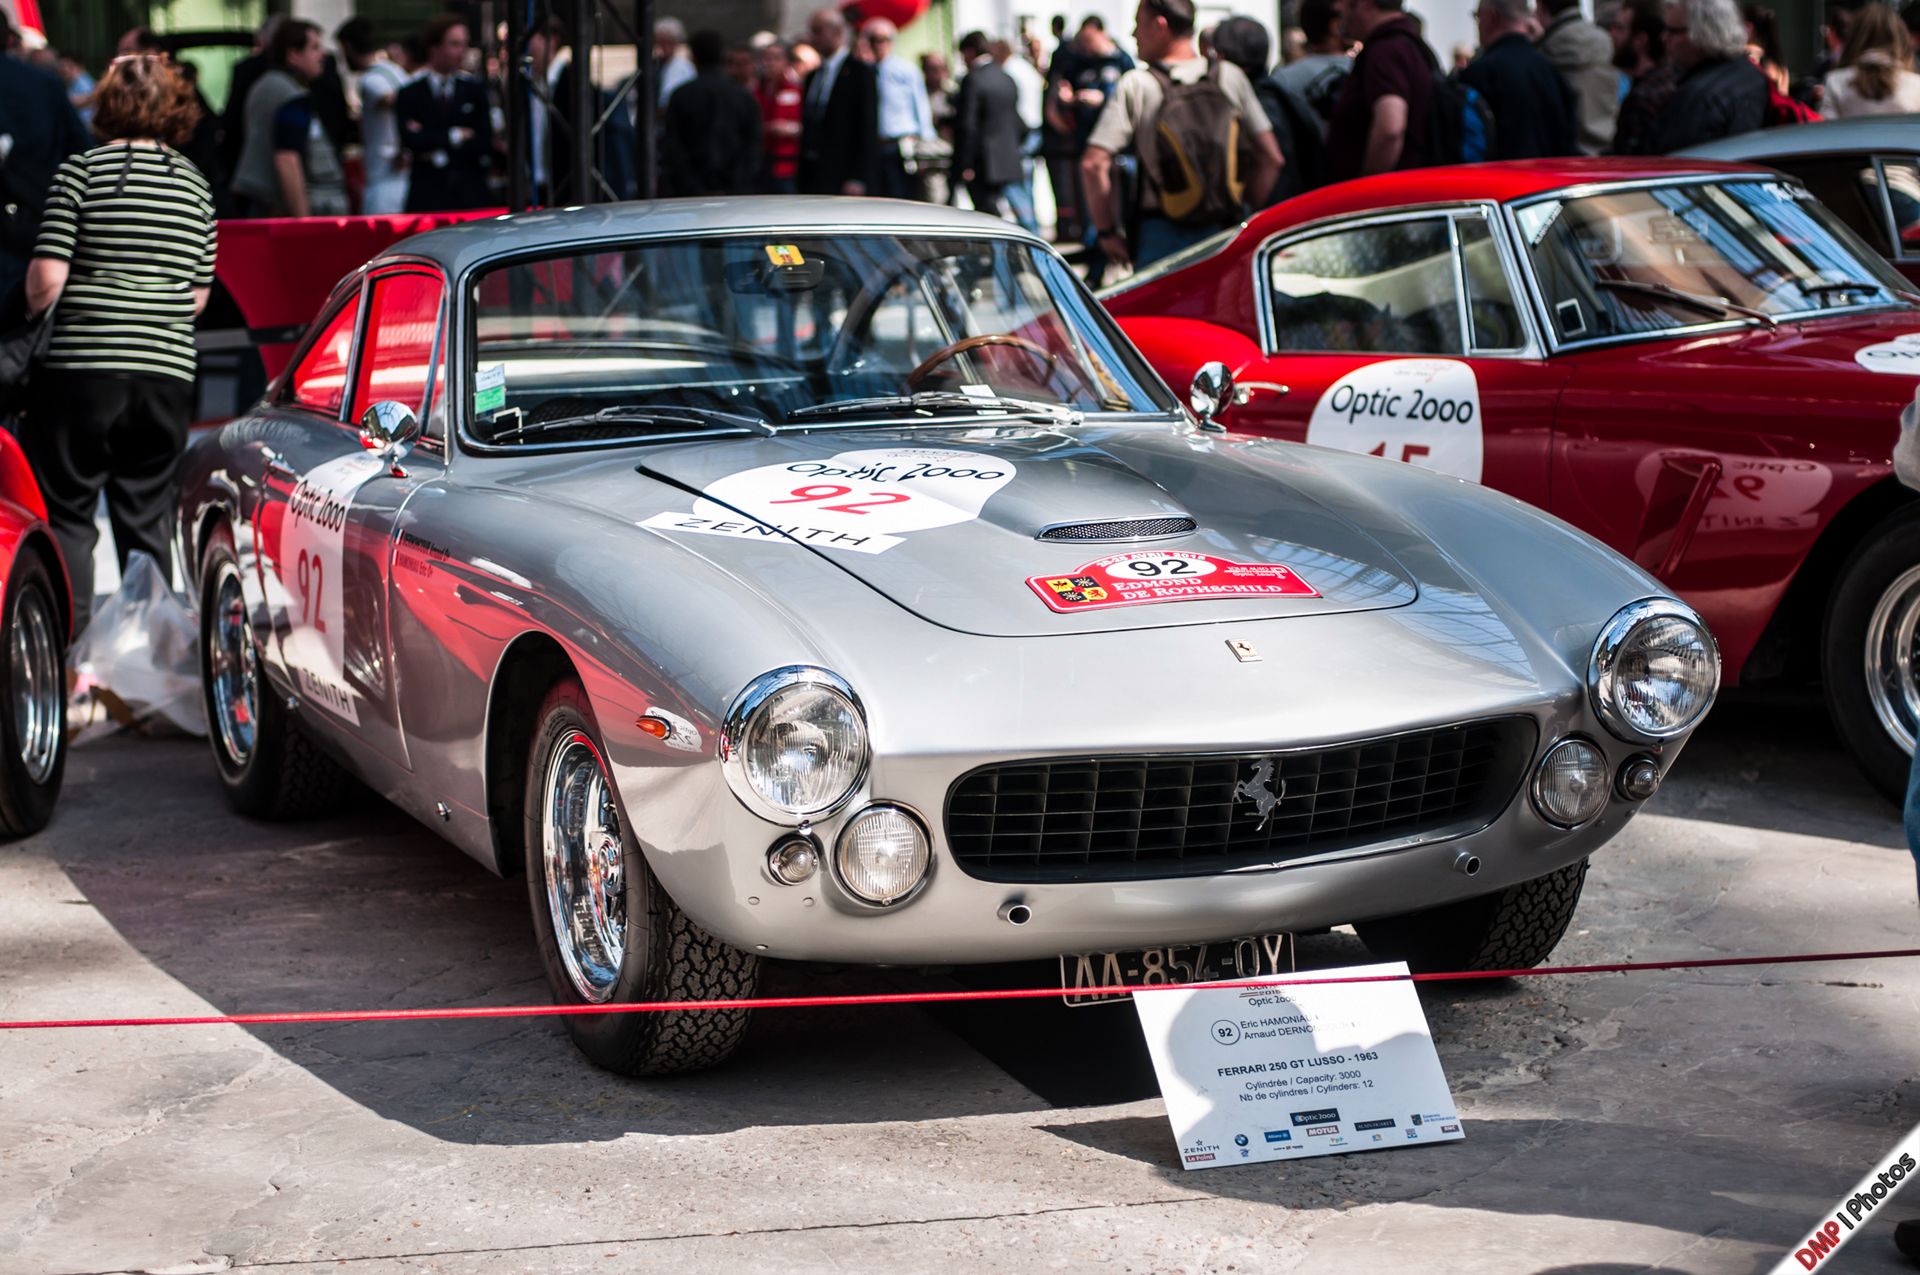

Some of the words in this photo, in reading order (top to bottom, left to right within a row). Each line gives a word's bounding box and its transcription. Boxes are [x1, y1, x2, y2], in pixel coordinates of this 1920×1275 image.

[1331, 385, 1402, 424] Optic
[1406, 389, 1473, 424] 2000
[786, 462, 898, 482] Optic
[898, 463, 1005, 483] 2000
[290, 480, 321, 529] Optic
[316, 489, 346, 533] 2000
[770, 484, 911, 515] 92
[674, 518, 871, 547] ZENITH
[1131, 552, 1170, 560] AVRIL
[1128, 559, 1198, 577] 92
[298, 548, 326, 634] 92
[1111, 577, 1202, 592] EDMOND
[1121, 590, 1151, 600] DE
[1151, 584, 1283, 598] ROTHSCHILD
[304, 668, 351, 714] ZENITH
[1248, 995, 1274, 1007] Optic
[1218, 1028, 1234, 1038] 92
[1240, 1020, 1259, 1030] Eric
[1244, 1030, 1277, 1040] Arnaud
[1217, 1064, 1267, 1077] FERRARI
[1269, 1061, 1288, 1071] 250
[1289, 1059, 1305, 1069] GT
[1308, 1055, 1346, 1067] LUSSO
[1354, 1051, 1379, 1062] 1963
[1245, 1077, 1288, 1091] Cylindrée
[1295, 1073, 1337, 1086] Capacity:
[1338, 1070, 1362, 1080] 3000
[1239, 1092, 1253, 1102] Nb
[1255, 1090, 1267, 1100] de
[1268, 1087, 1309, 1100] cylindres
[1316, 1081, 1361, 1094] Cylinders:
[1362, 1079, 1375, 1089] 12
[1297, 1114, 1318, 1123] Optic
[1308, 1126, 1338, 1136] MOTUL
[1183, 1144, 1220, 1153] ZENITH
[1196, 1153, 1214, 1161] Point
